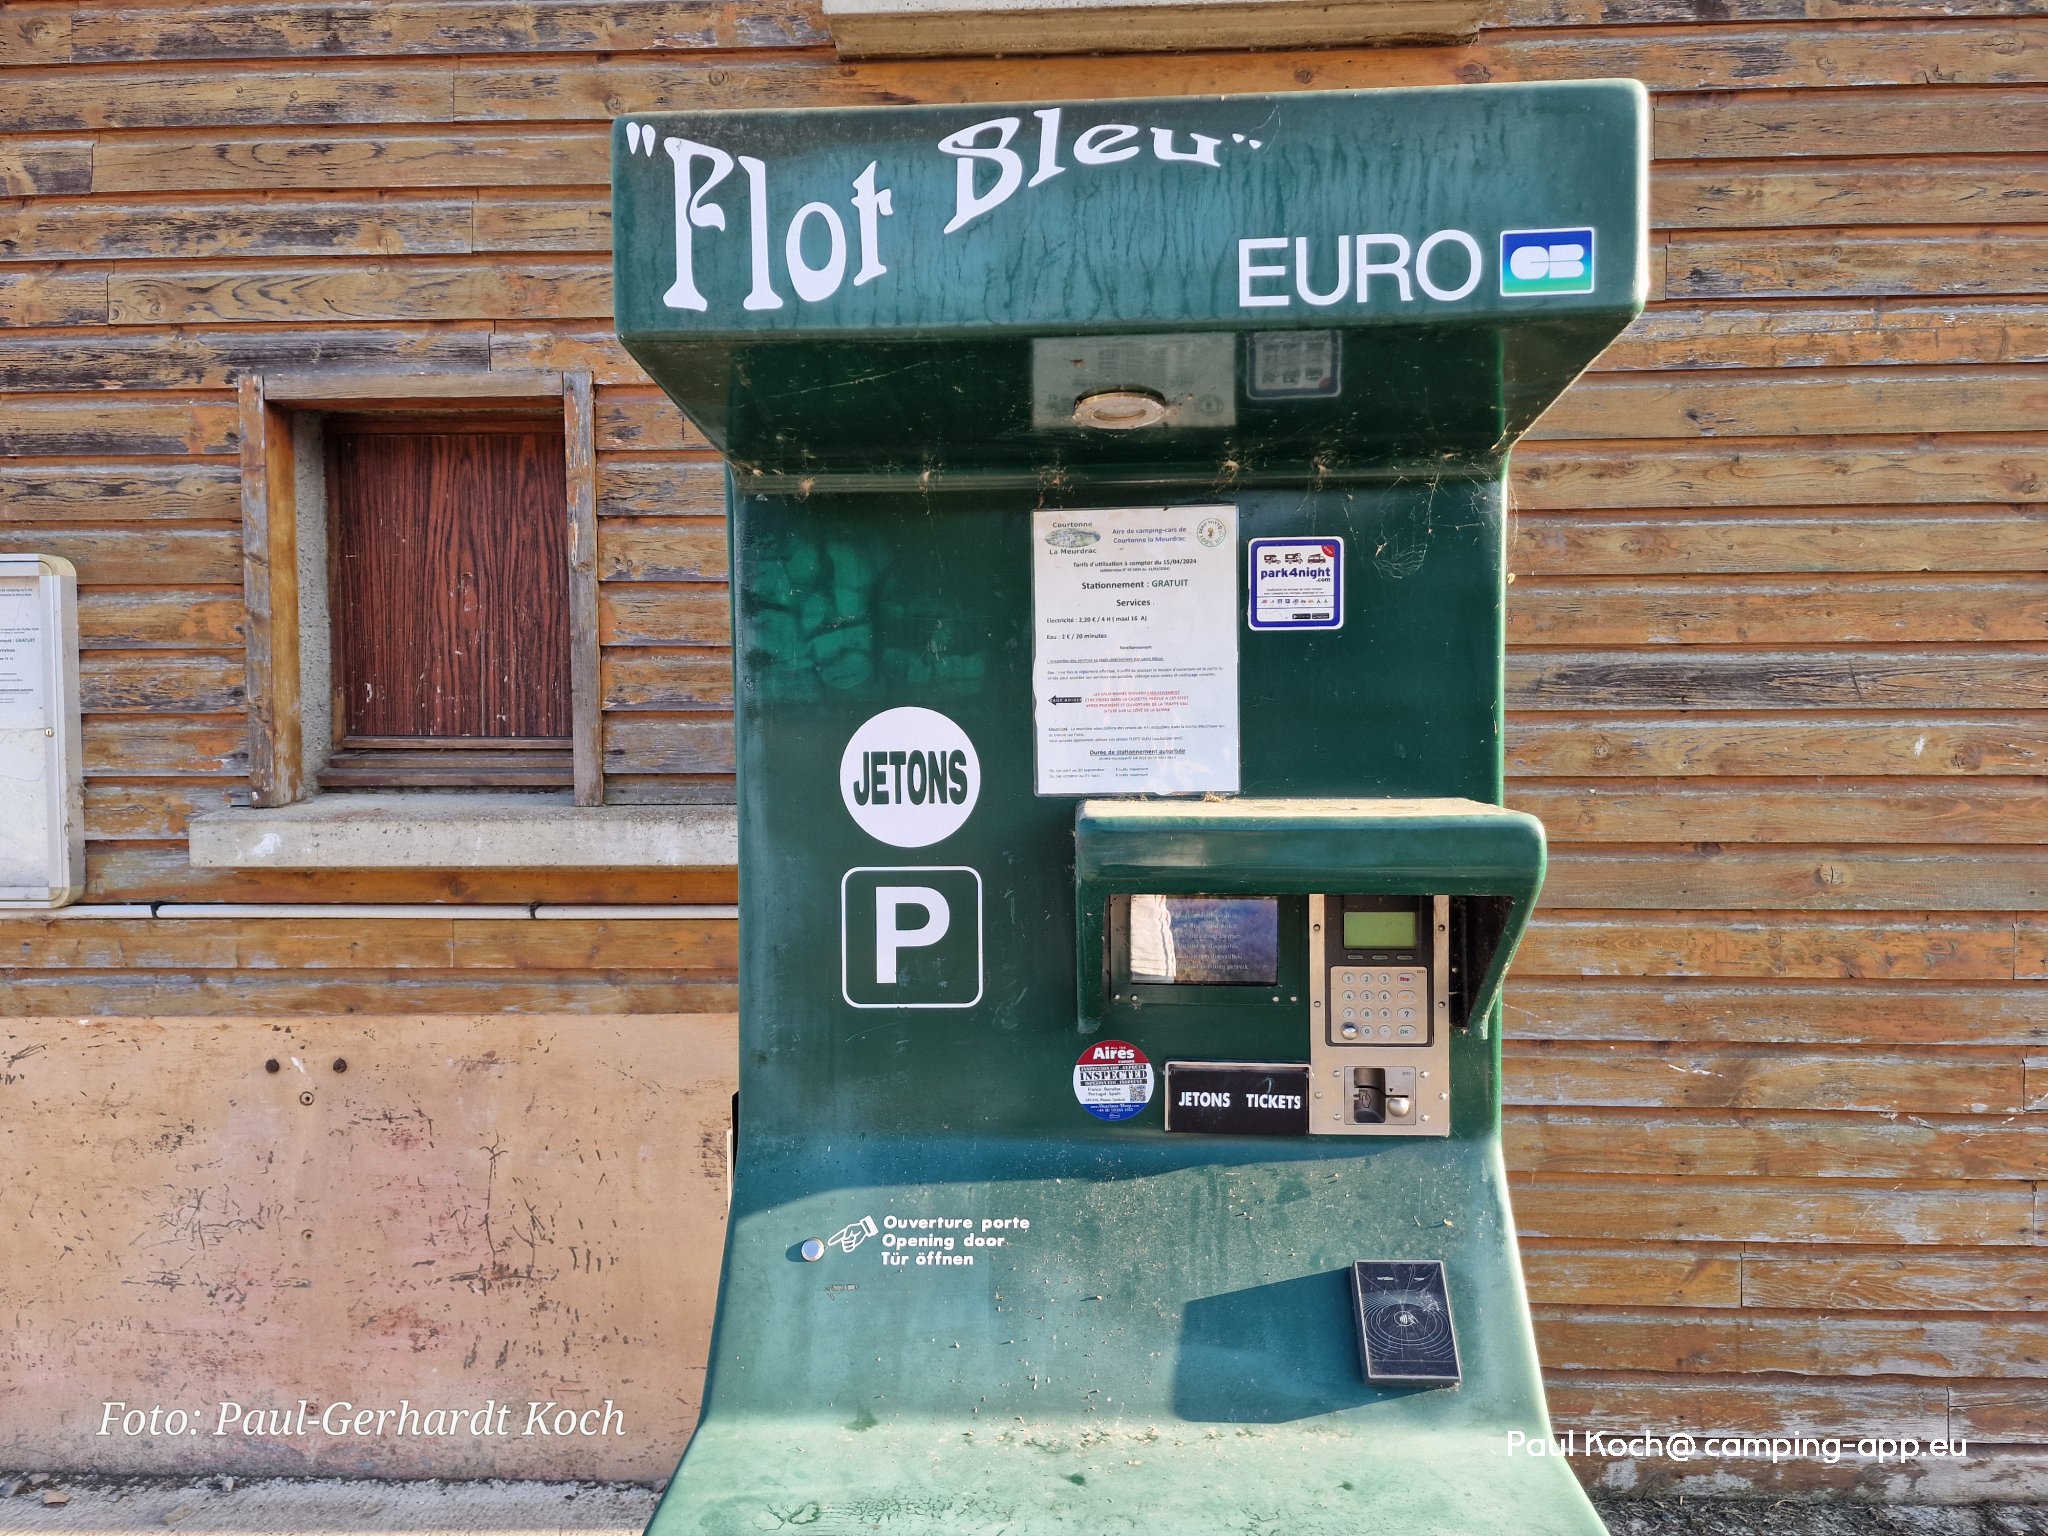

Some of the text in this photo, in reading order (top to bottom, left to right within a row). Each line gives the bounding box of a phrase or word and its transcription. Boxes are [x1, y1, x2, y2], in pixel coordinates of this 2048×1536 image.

[1238, 229, 1482, 307] EURO
[1135, 527, 1177, 535] camping-cars
[1260, 567, 1331, 580] park4night
[1081, 580, 1144, 590] Stationnement
[1151, 579, 1189, 588] GRATUIT
[1116, 599, 1151, 607] Services
[853, 749, 968, 806] JETONS
[876, 886, 950, 984] P
[1093, 1046, 1135, 1060] Aires
[1080, 1070, 1147, 1080] INSPECTED
[1178, 1092, 1301, 1110] JETONS TICKETS
[883, 1215, 1030, 1232] Ouverture porte
[882, 1233, 1005, 1250] Opening door
[881, 1251, 974, 1265] Tür öffnen
